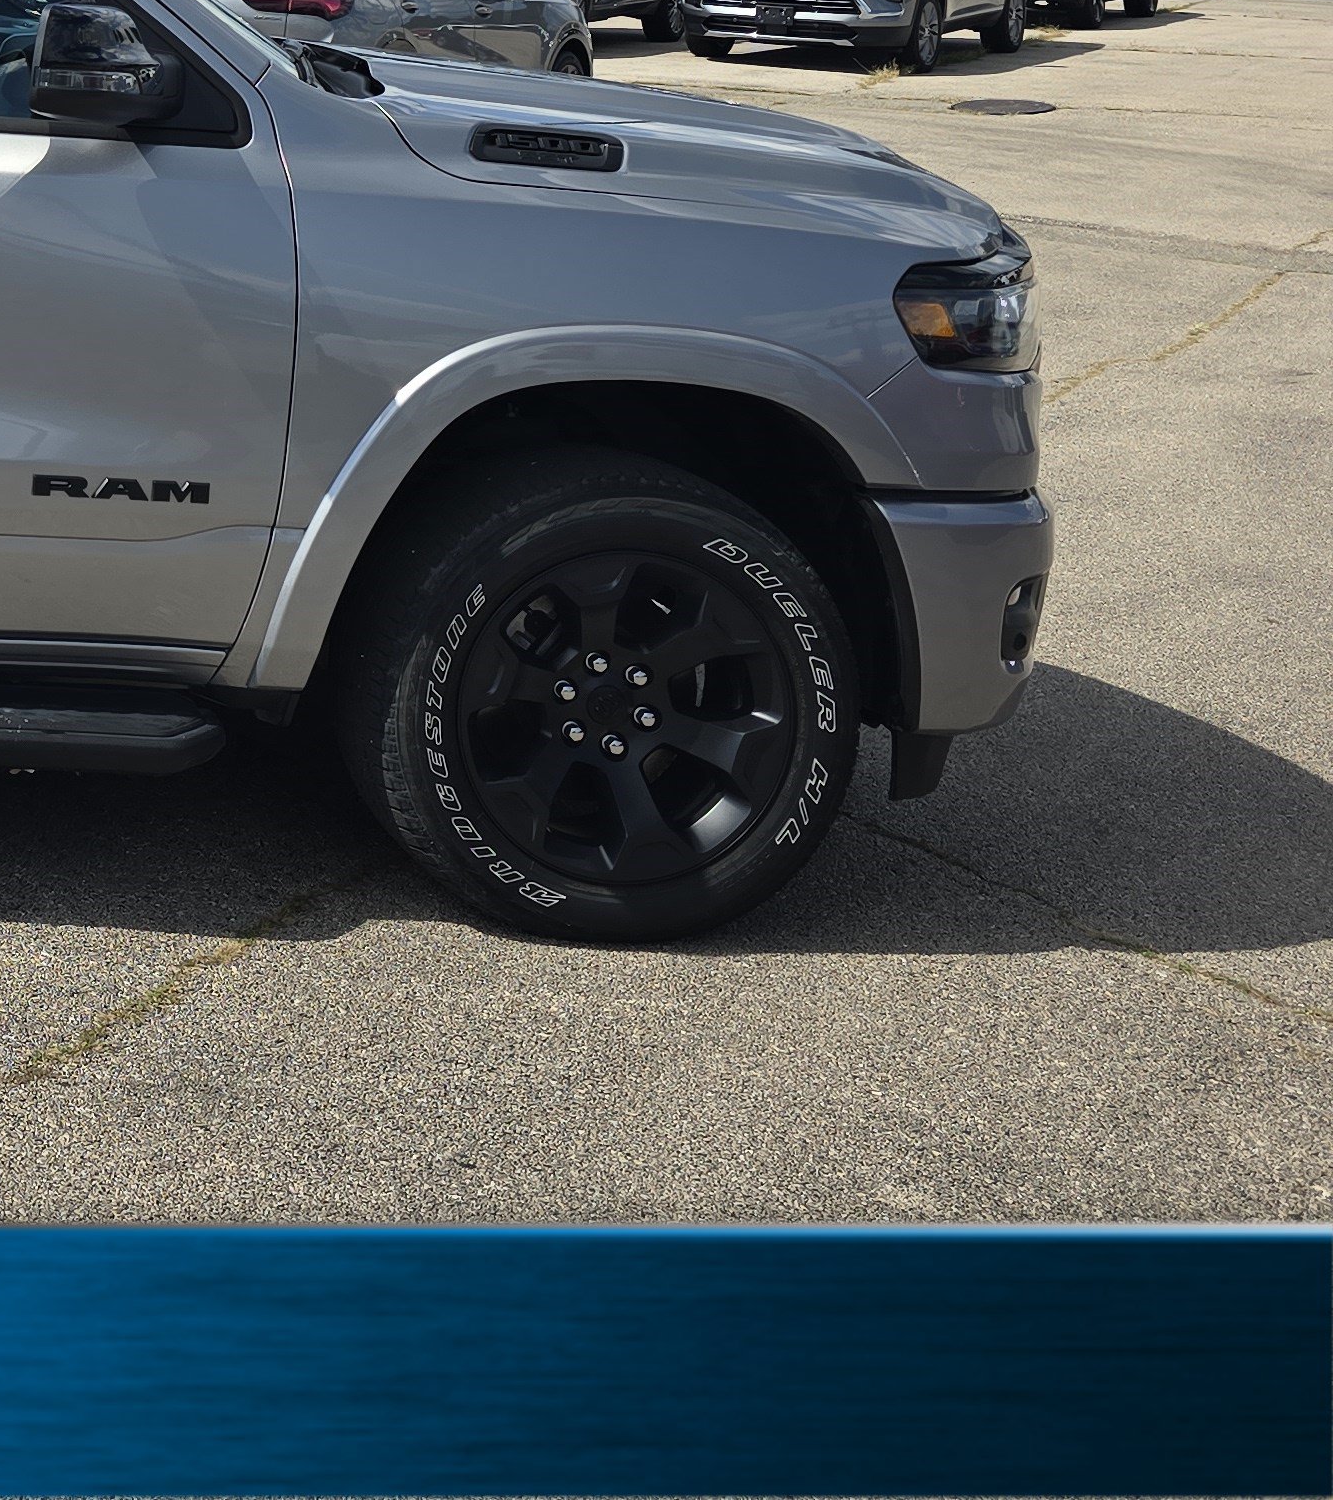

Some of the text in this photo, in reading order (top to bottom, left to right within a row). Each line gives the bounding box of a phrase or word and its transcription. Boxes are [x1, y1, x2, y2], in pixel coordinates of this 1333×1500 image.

[493, 132, 603, 155] 1500
[31, 473, 211, 505] RAM
[424, 583, 568, 908] BRIDGESTONE
[702, 537, 837, 845] DUELER H/L
